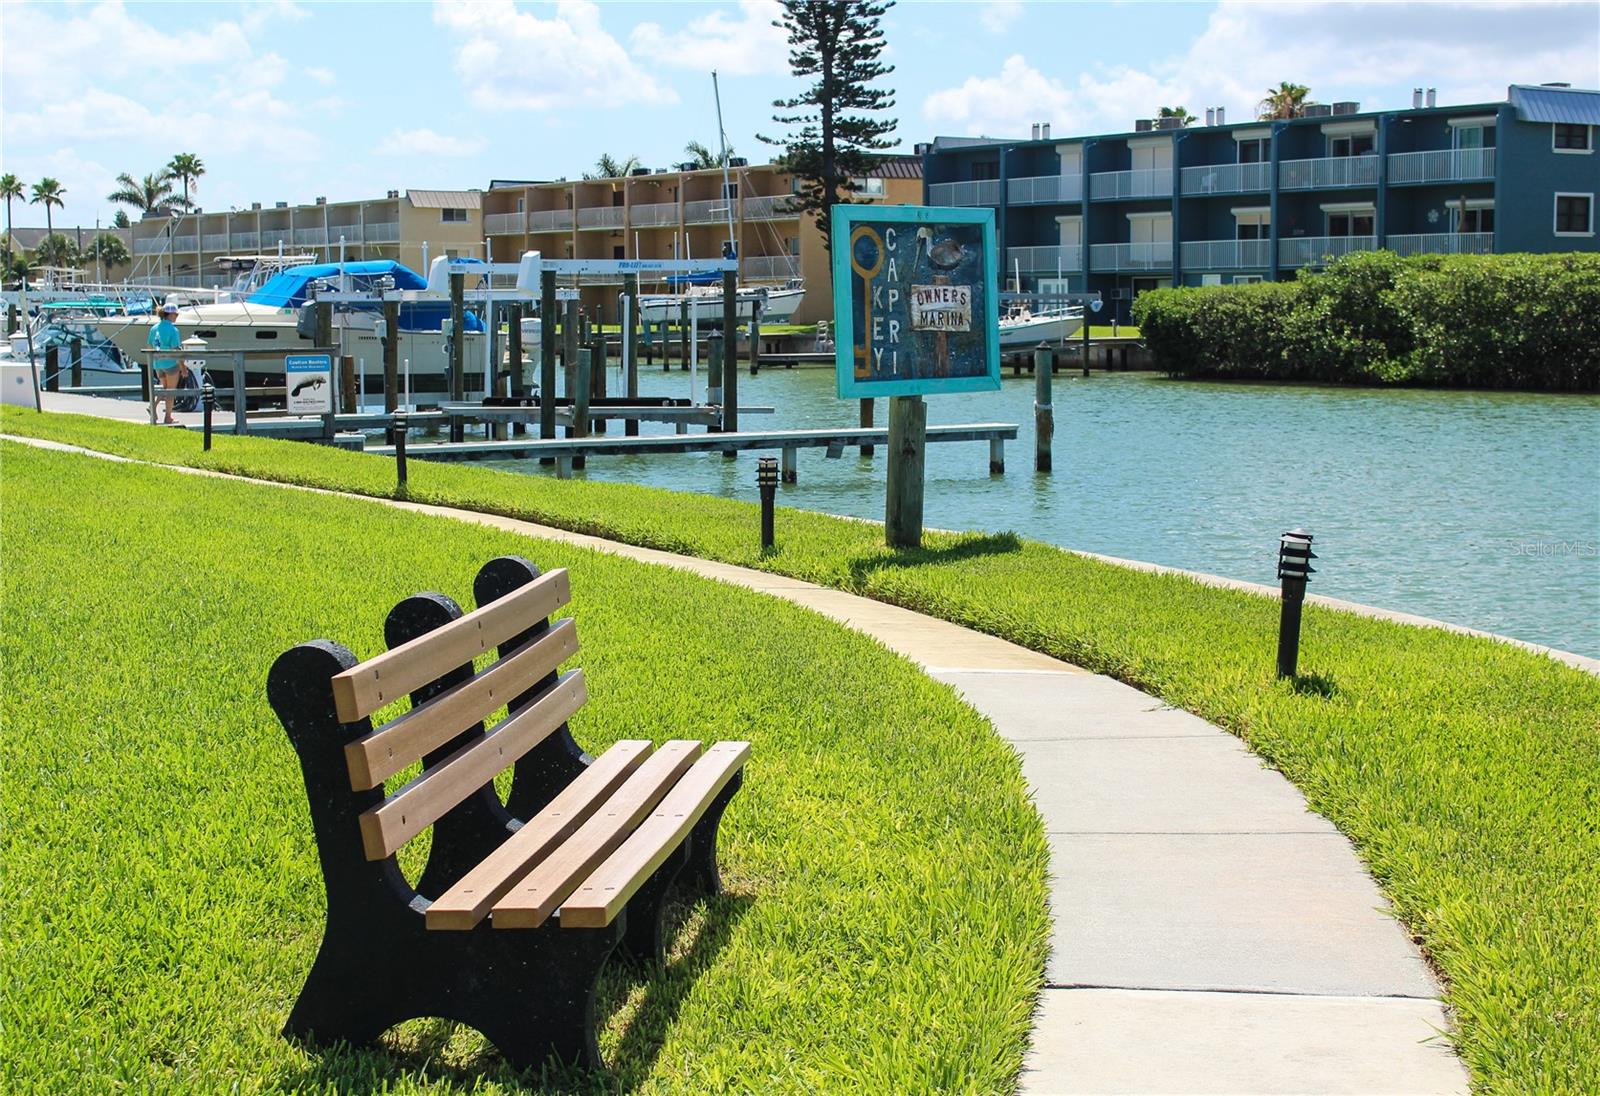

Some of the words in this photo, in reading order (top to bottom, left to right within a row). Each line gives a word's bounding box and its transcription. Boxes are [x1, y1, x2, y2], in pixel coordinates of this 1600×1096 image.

[886, 228, 900, 374] CAPRI
[917, 288, 966, 306] OWNERS
[920, 311, 964, 327] MARINA
[872, 286, 884, 371] KEY
